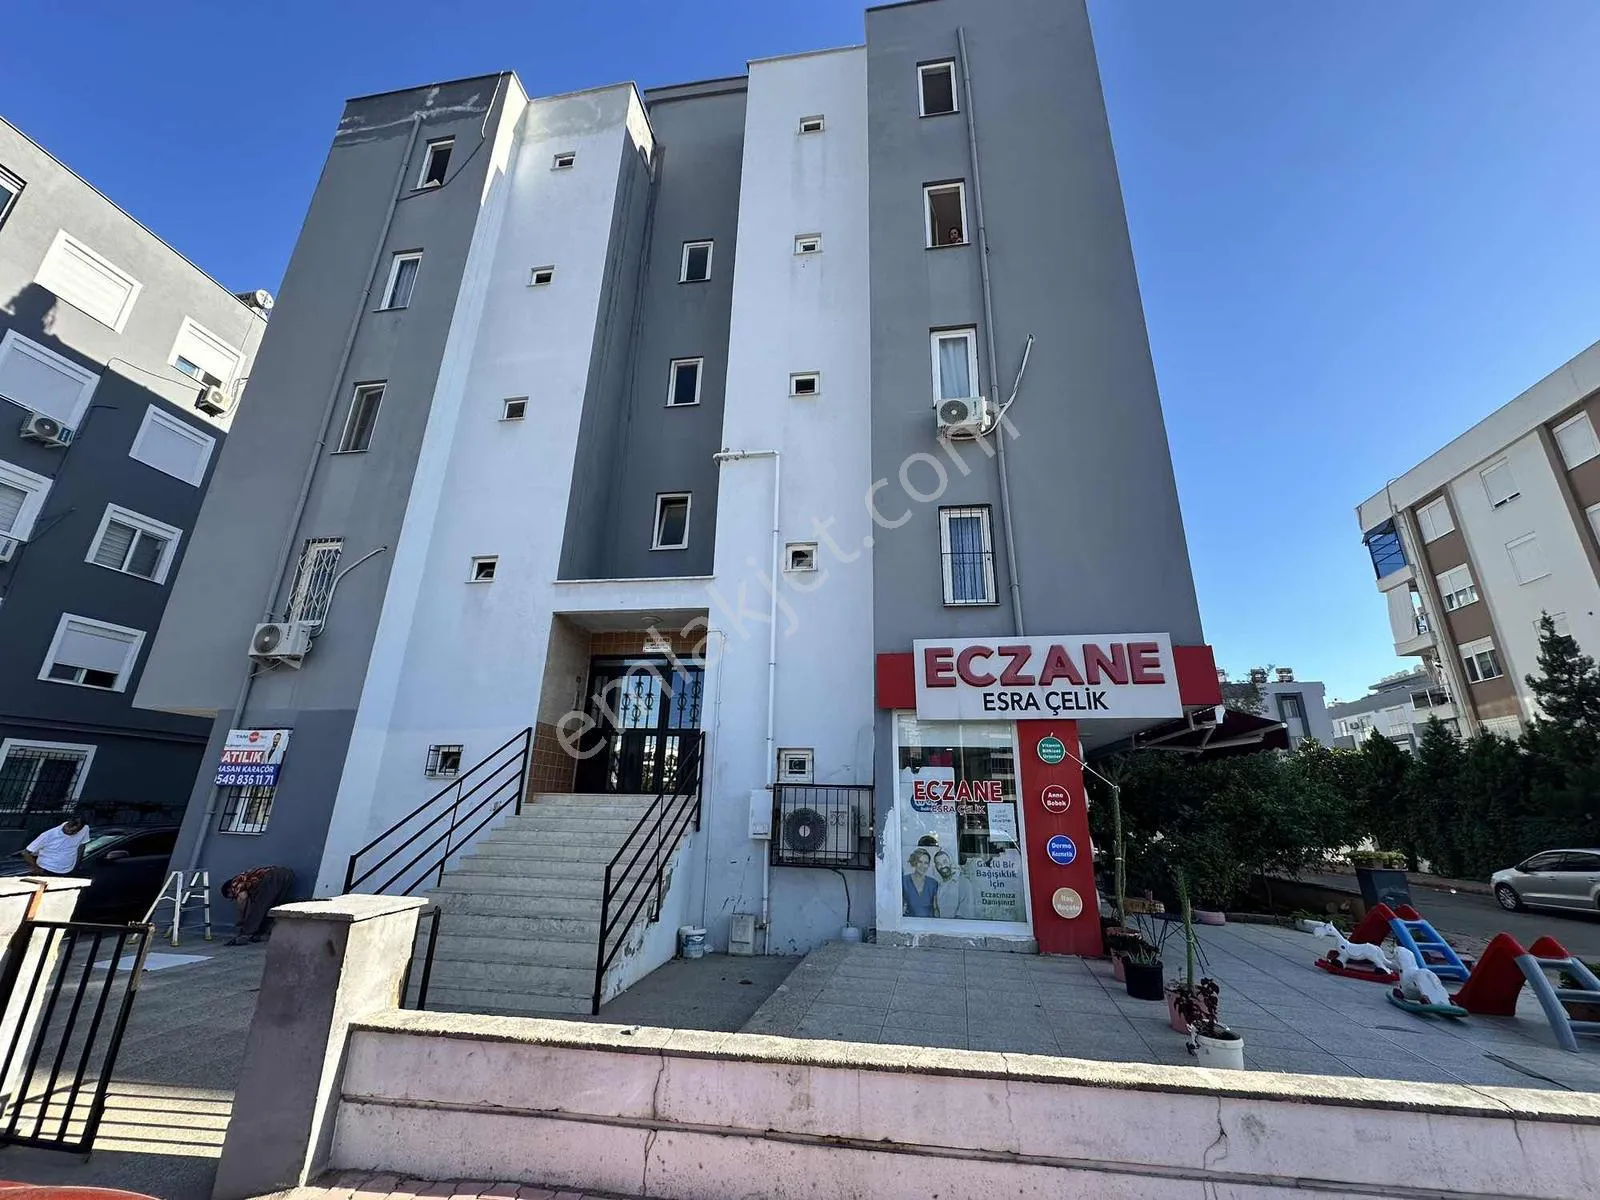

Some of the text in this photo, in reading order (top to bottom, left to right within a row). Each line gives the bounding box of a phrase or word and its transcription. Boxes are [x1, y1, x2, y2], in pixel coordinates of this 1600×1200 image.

[925, 642, 1166, 688] ECZANE
[983, 687, 1109, 716] ESRA ÇELİK
[237, 774, 254, 785] 836
[264, 774, 274, 785] 71
[913, 780, 1003, 802] ECZANE
[931, 805, 956, 814] ESRA
[957, 804, 986, 816] ÇELİK
[976, 860, 1015, 869] Glü Bir
